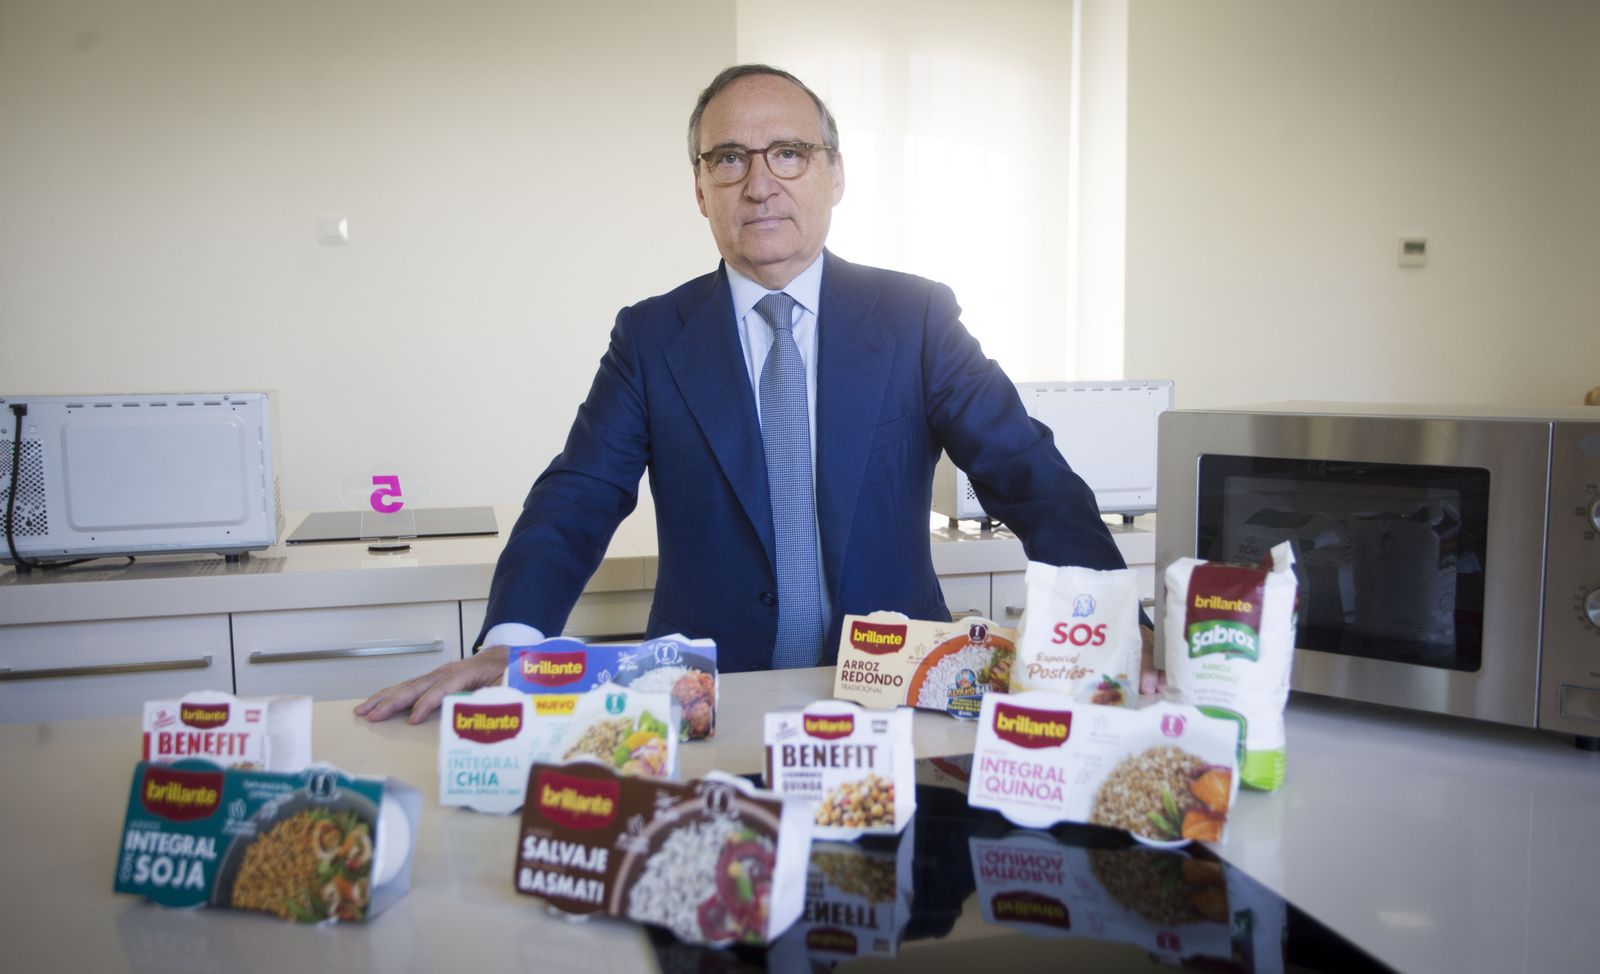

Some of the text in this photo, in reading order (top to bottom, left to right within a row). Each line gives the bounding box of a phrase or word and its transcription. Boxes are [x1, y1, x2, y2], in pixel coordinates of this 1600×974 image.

[1195, 595, 1253, 613] brillante
[854, 628, 902, 645] brillante
[1051, 622, 1109, 646] SOS
[843, 659, 879, 671] ARROZ
[1036, 652, 1080, 663] Especial
[523, 660, 583, 675] brillante
[841, 671, 903, 687] REDONDO
[841, 683, 882, 694] TRADICIONAL
[182, 707, 228, 722] brillante
[536, 700, 574, 712] NUEVO
[455, 713, 520, 731] brillante
[805, 718, 852, 732] brillante
[997, 712, 1067, 739] brillante
[158, 732, 250, 756] BENEFIT
[448, 756, 521, 769] INTEGRAL
[782, 744, 877, 768] BENEFIT
[456, 768, 499, 787] CHÍA
[981, 757, 1066, 785] INTEGRAL
[146, 781, 217, 806] brillante
[782, 780, 822, 792] QUINOA
[986, 776, 1064, 803] QUINOA
[541, 785, 613, 816] brillante
[125, 830, 218, 860] INTEGRAL
[522, 835, 609, 874] SALVAJE
[133, 854, 205, 891] SOJA
[518, 867, 605, 905] BASMATI
